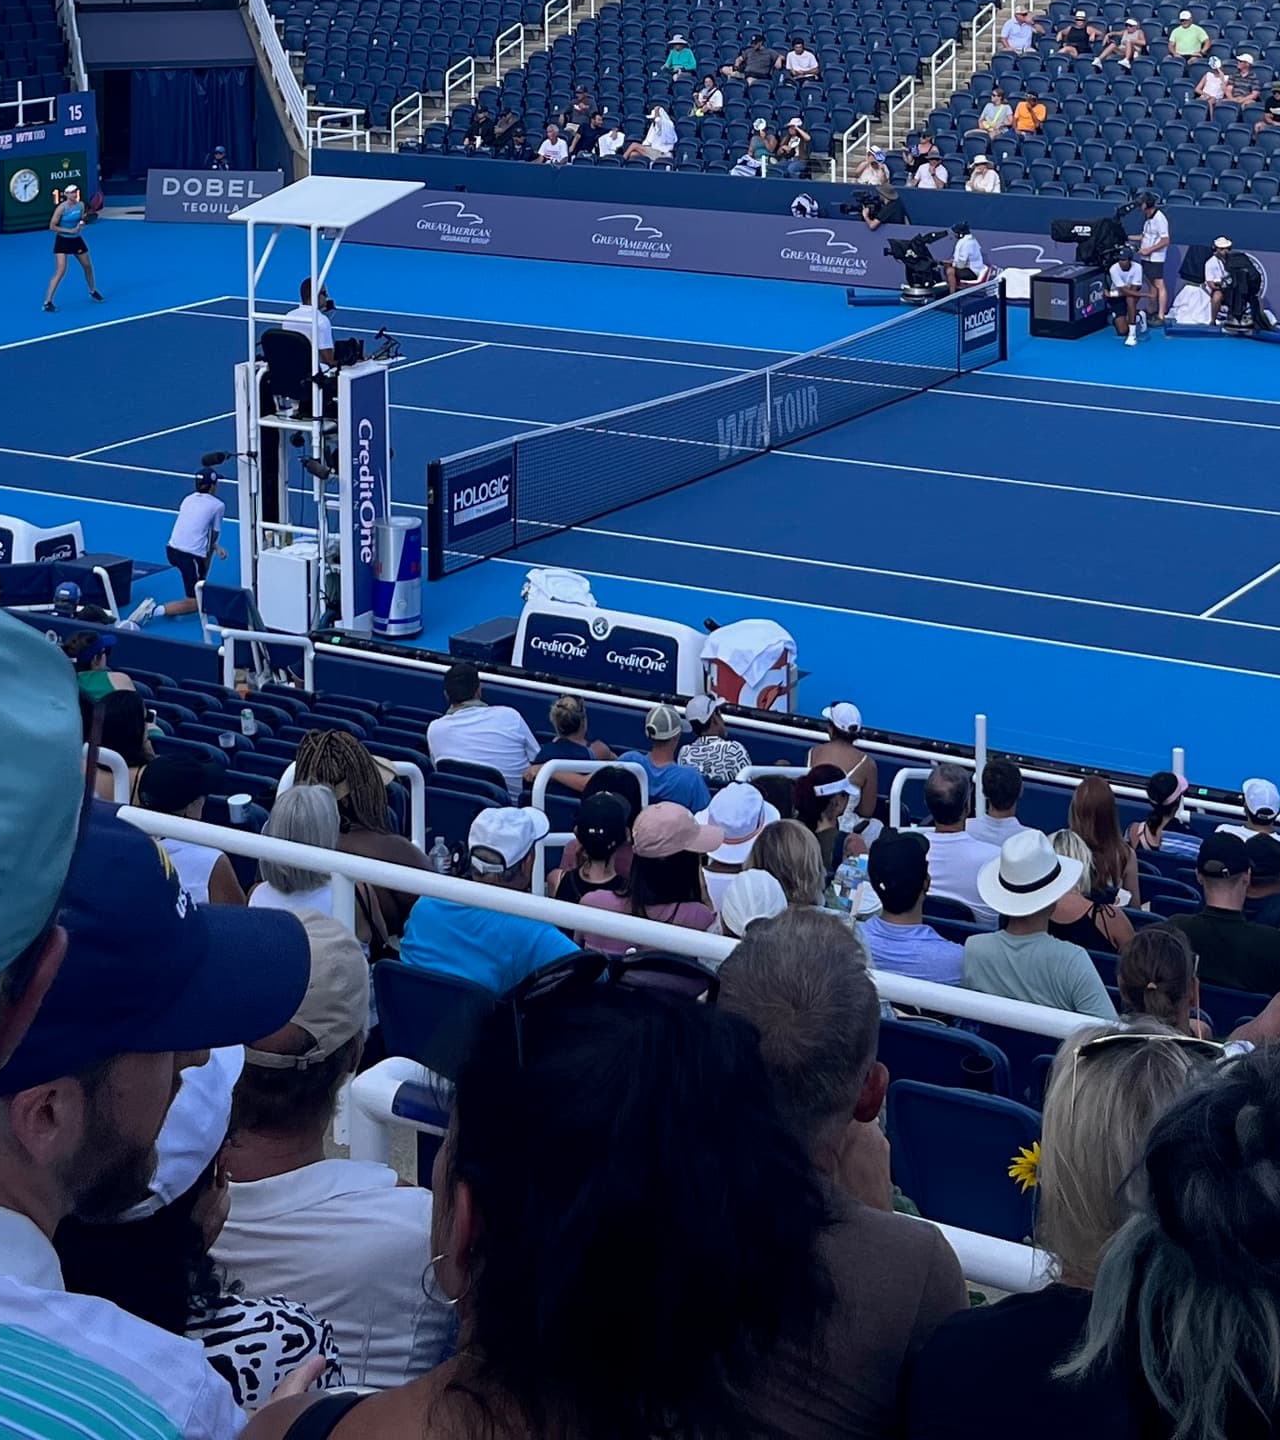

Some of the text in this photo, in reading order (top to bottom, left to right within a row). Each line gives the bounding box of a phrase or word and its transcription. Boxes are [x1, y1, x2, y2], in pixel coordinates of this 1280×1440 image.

[68, 104, 83, 121] 15
[51, 168, 81, 180] ROLEX
[162, 177, 263, 199] DOBEL
[182, 201, 240, 213] TEQUILA
[809, 264, 867, 276] INSURANCE GROUP
[964, 307, 996, 330] HOLOGIC
[717, 386, 819, 461] WTA TOUR
[453, 474, 510, 511] HOLOGIC
